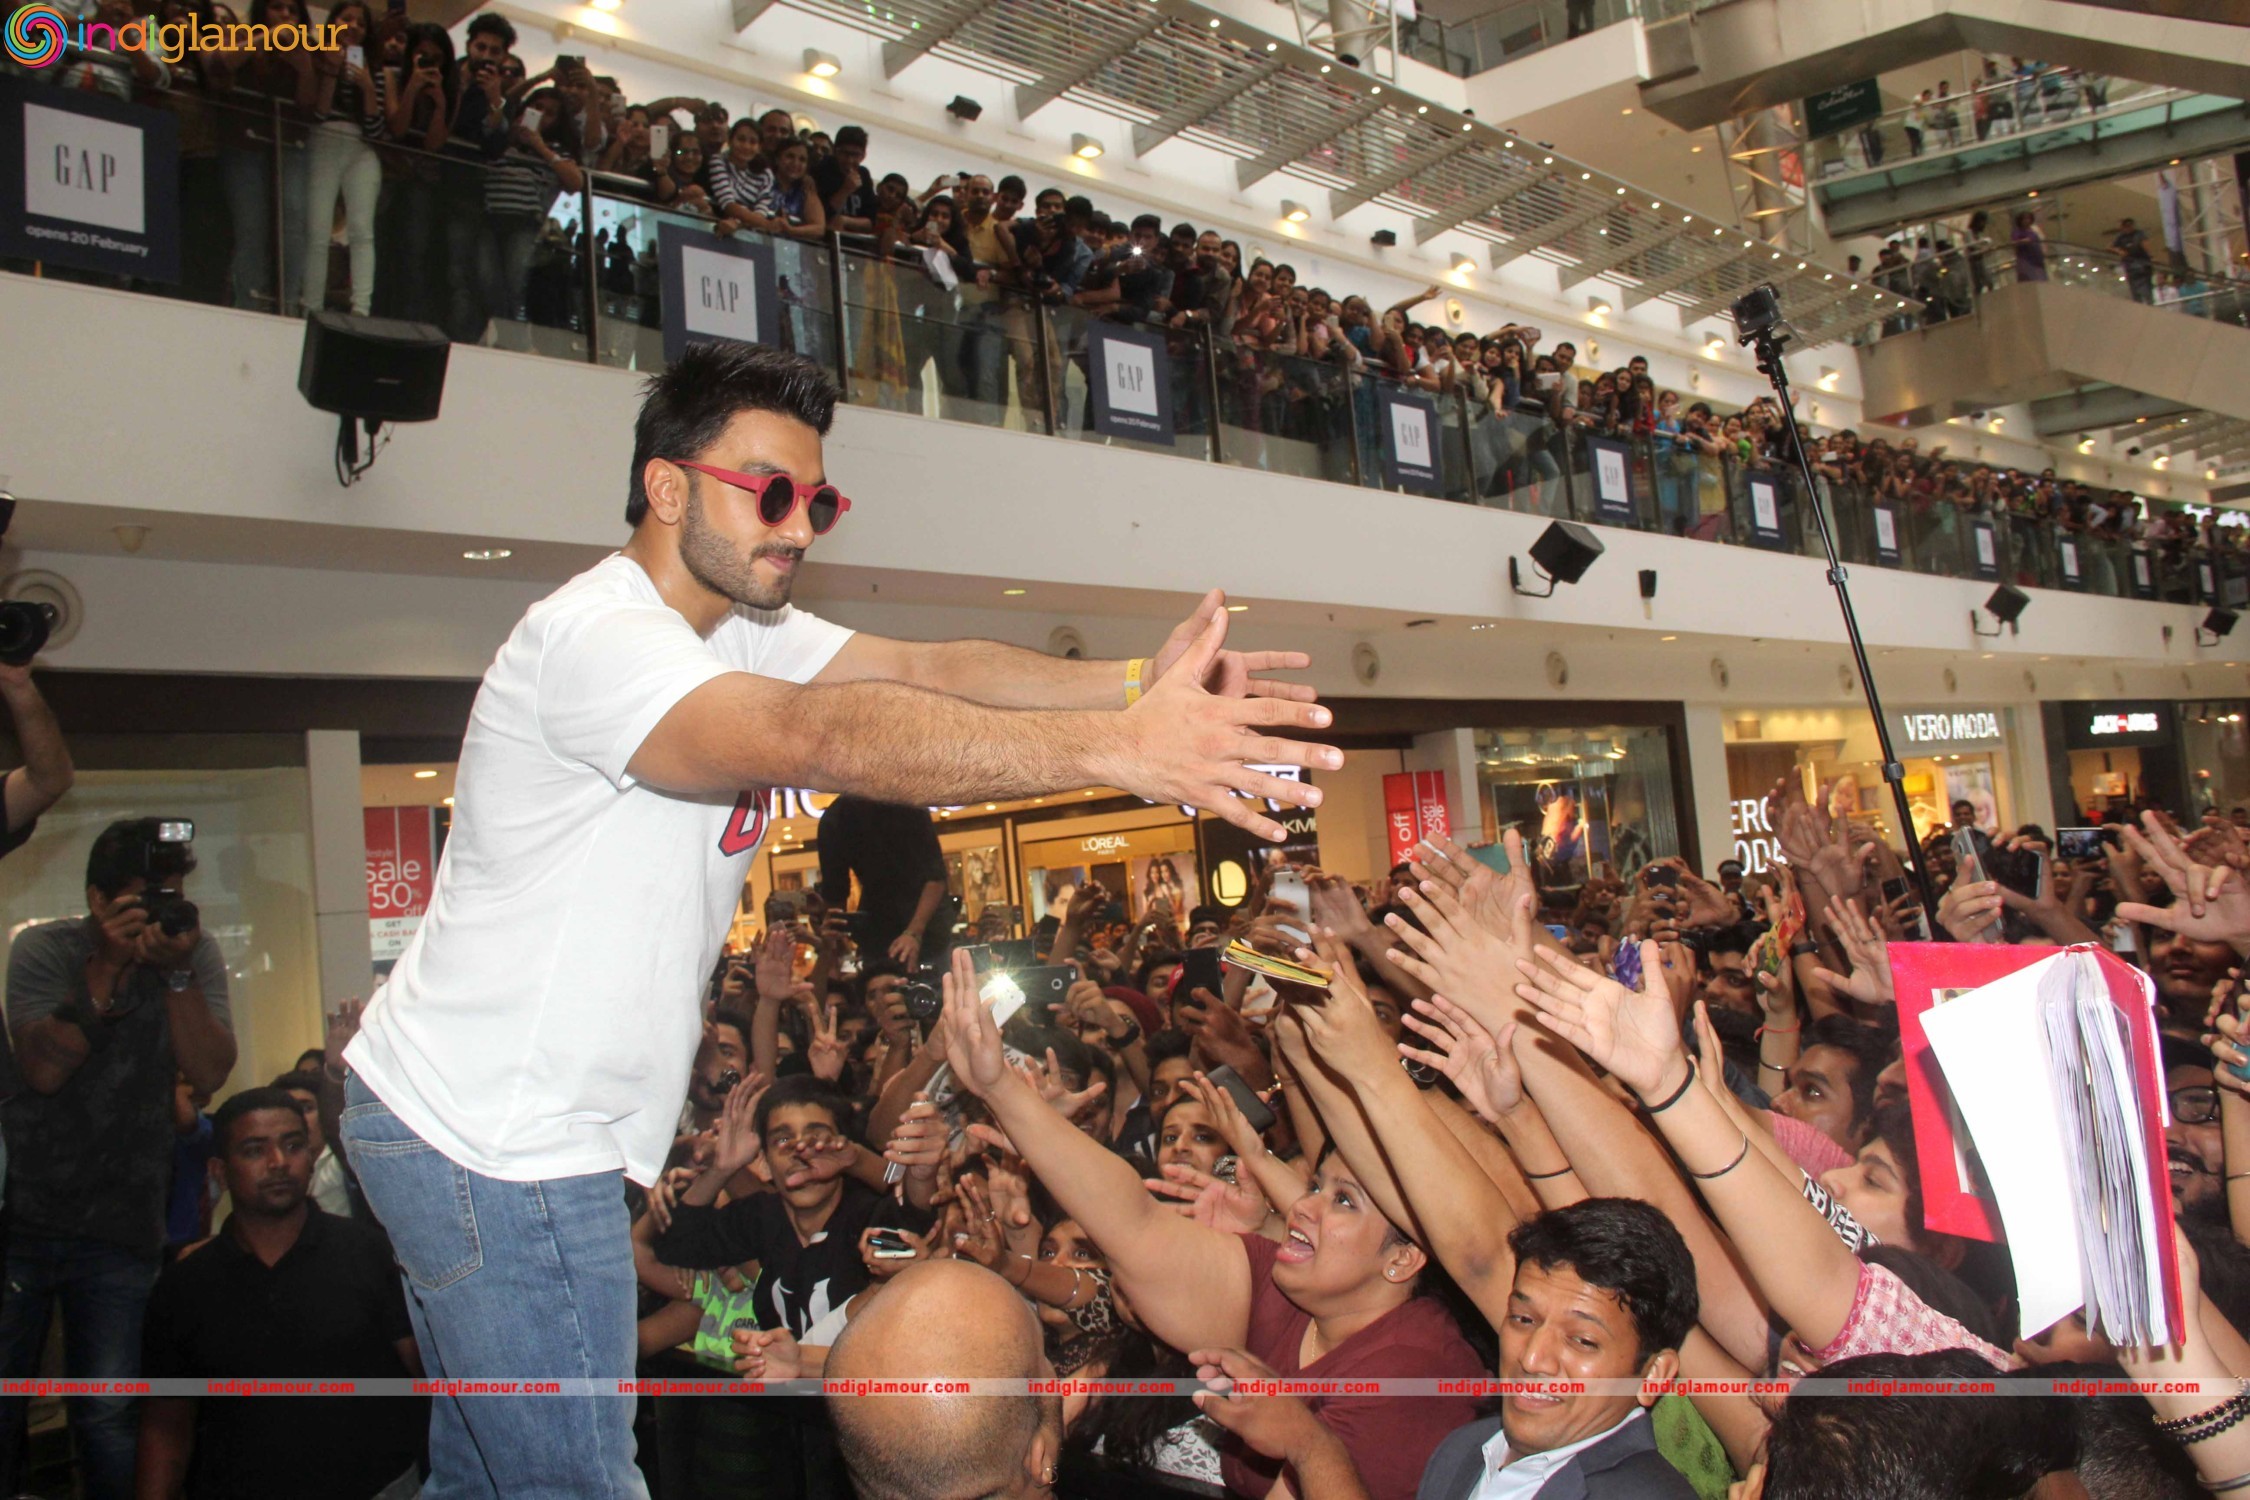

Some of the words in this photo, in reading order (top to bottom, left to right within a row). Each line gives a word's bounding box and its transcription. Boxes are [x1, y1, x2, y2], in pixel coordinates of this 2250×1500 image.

[55, 143, 116, 194] GAP
[25, 225, 68, 241] opens
[70, 231, 89, 245] 20
[91, 235, 149, 258] February
[701, 275, 739, 314] GAP
[1117, 361, 1143, 393] GAP
[1903, 713, 1951, 742] VERO
[1952, 712, 2000, 739] MODA
[366, 858, 421, 882] sale
[1733, 836, 1788, 877] ODA
